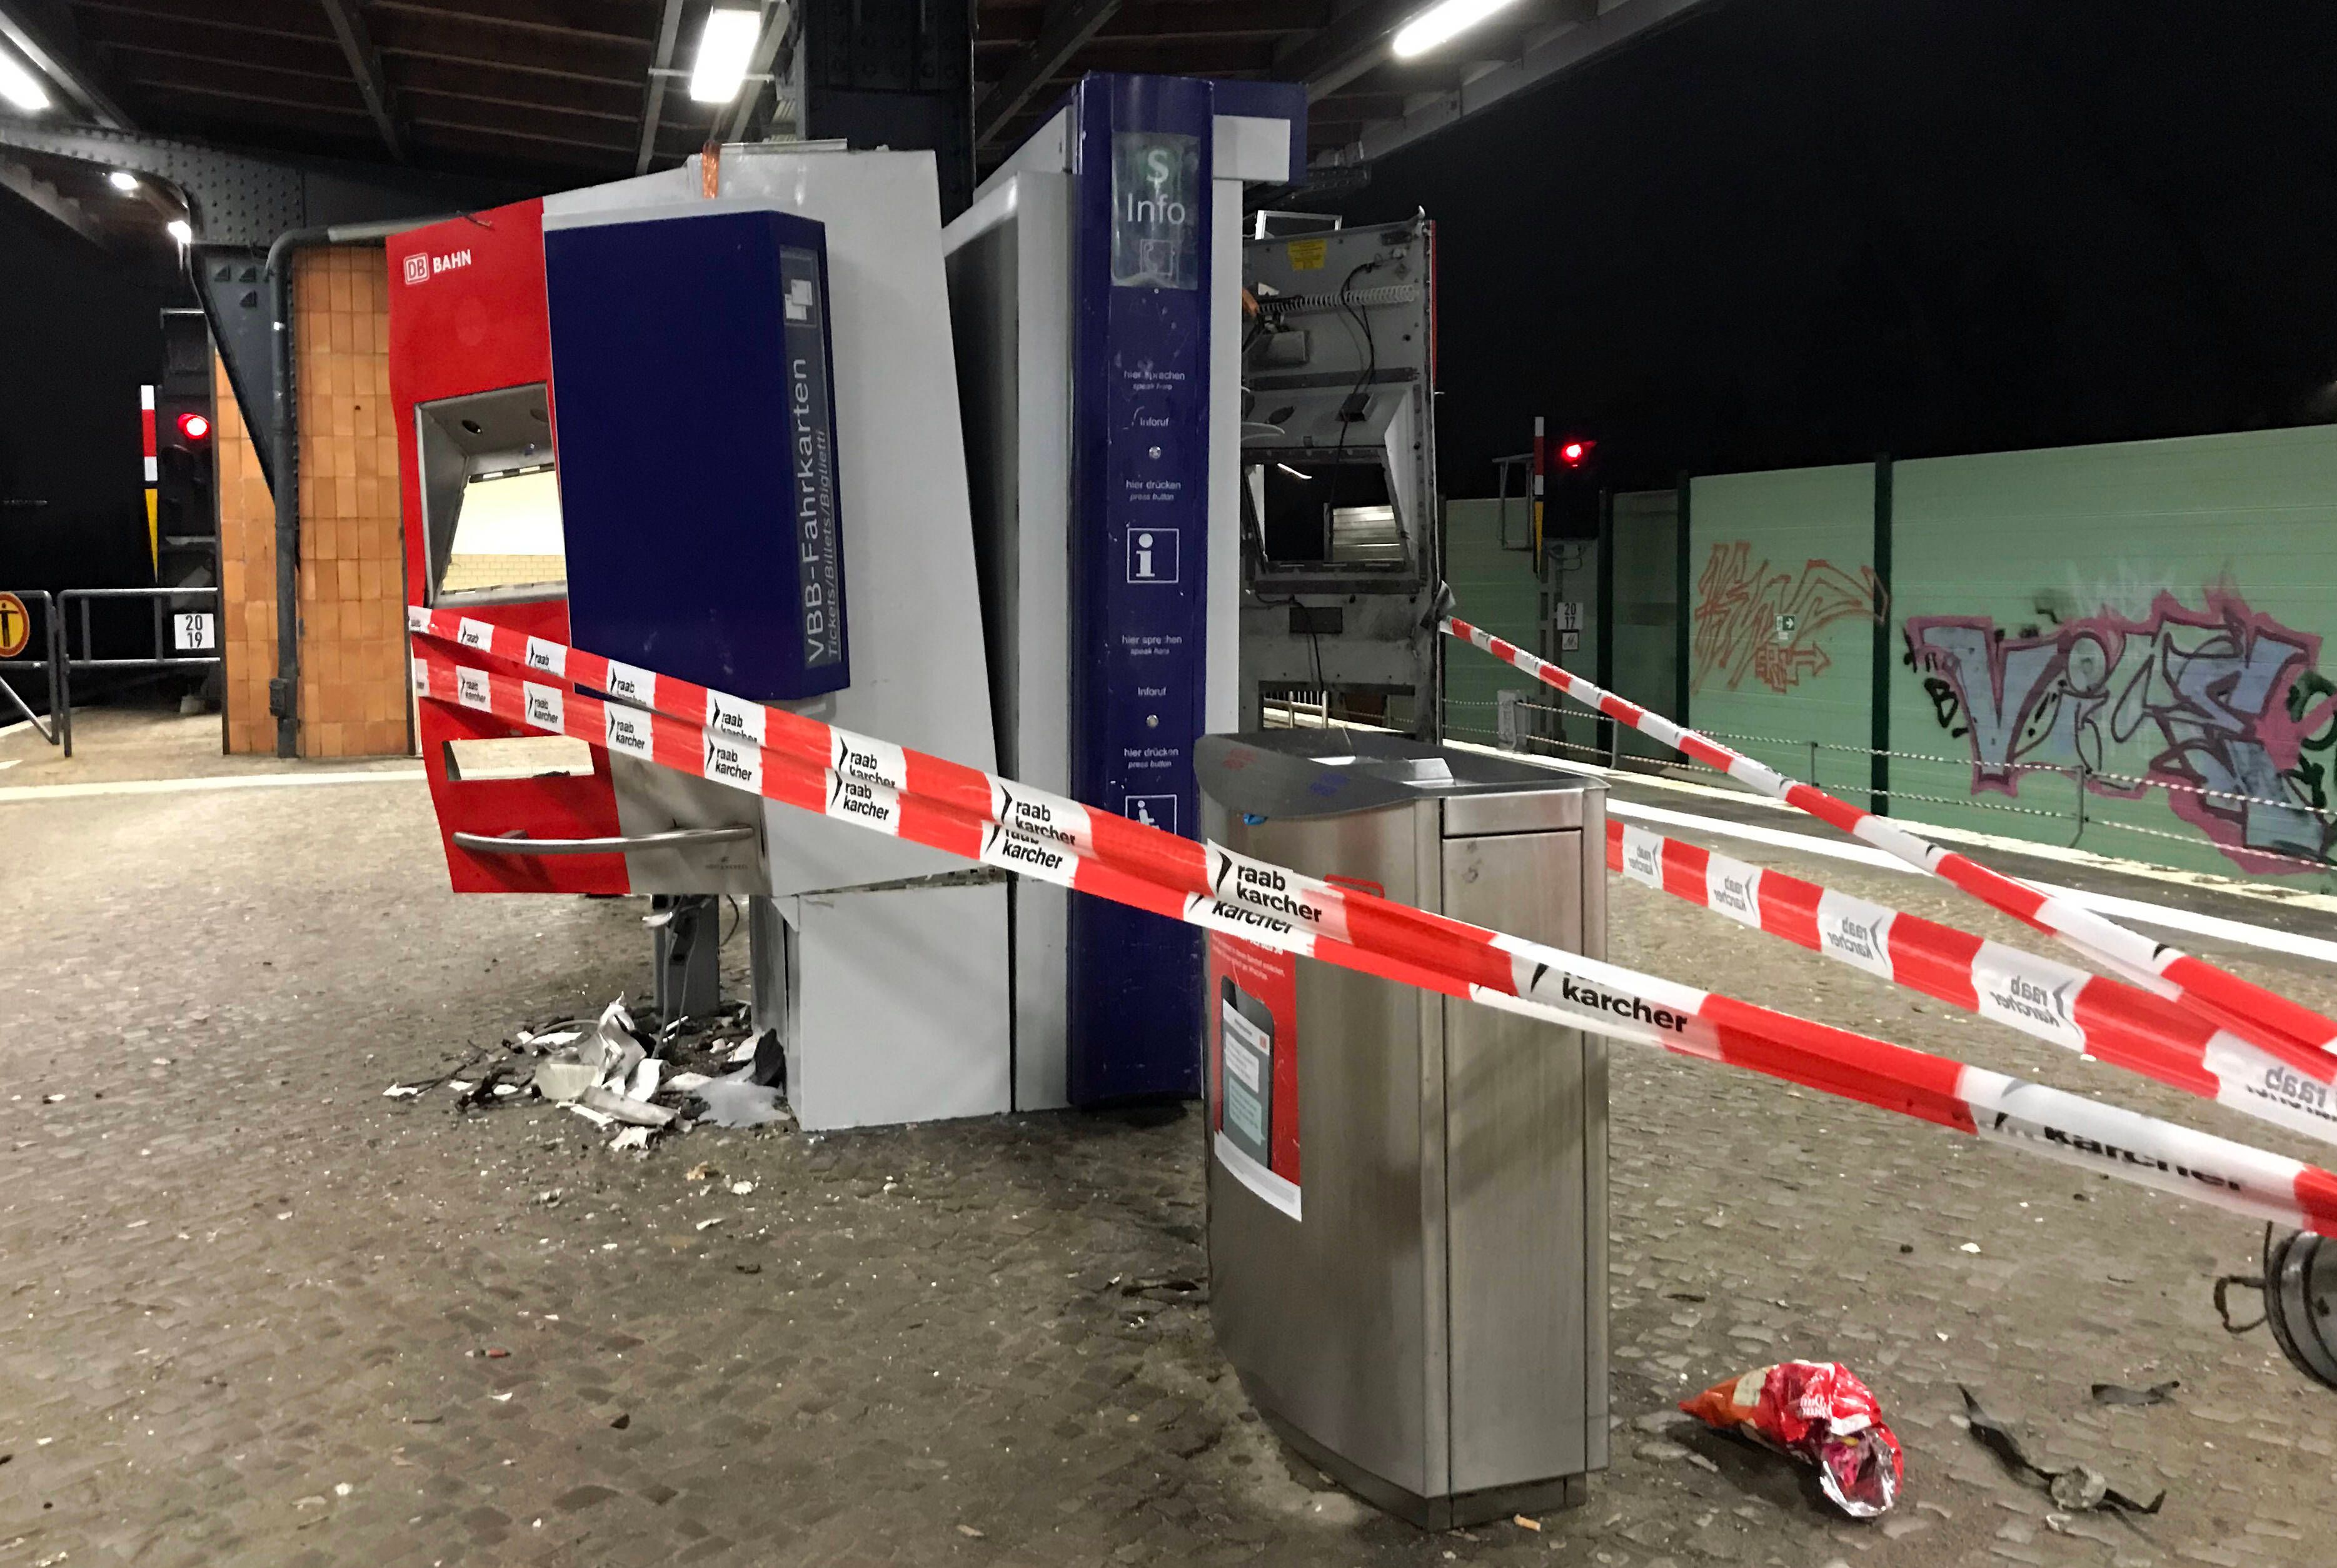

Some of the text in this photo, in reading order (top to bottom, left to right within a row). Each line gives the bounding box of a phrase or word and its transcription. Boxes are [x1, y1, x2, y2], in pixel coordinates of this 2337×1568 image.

[1128, 193, 1186, 225] Info
[433, 249, 471, 274] BAHN
[1140, 417, 1169, 427] Inforuf
[1126, 480, 1143, 489] hier
[793, 359, 825, 662] VBB-Fahrkarten
[1564, 603, 1577, 616] 20
[185, 615, 203, 631] 20
[187, 631, 203, 648] 19
[1122, 635, 1182, 645] hier sprehen
[535, 654, 550, 666] raab
[617, 679, 635, 694] raab
[1138, 686, 1167, 696] Inforuf
[535, 698, 549, 710] raab
[533, 708, 559, 724] karcher
[721, 712, 743, 728] raab
[616, 720, 635, 734] raab
[615, 732, 645, 750] karcher
[716, 747, 739, 763] raab
[850, 751, 878, 770] raab
[1123, 748, 1142, 757] hier
[715, 760, 753, 781] karcher
[845, 782, 872, 800] raab
[843, 794, 890, 821] karcher
[1015, 800, 1051, 822] raab
[1015, 815, 1076, 847] karcher
[1002, 838, 1064, 870] karcher
[1237, 864, 1287, 892] raab
[1236, 880, 1323, 923] karcher
[1562, 977, 1688, 1033] karcher
